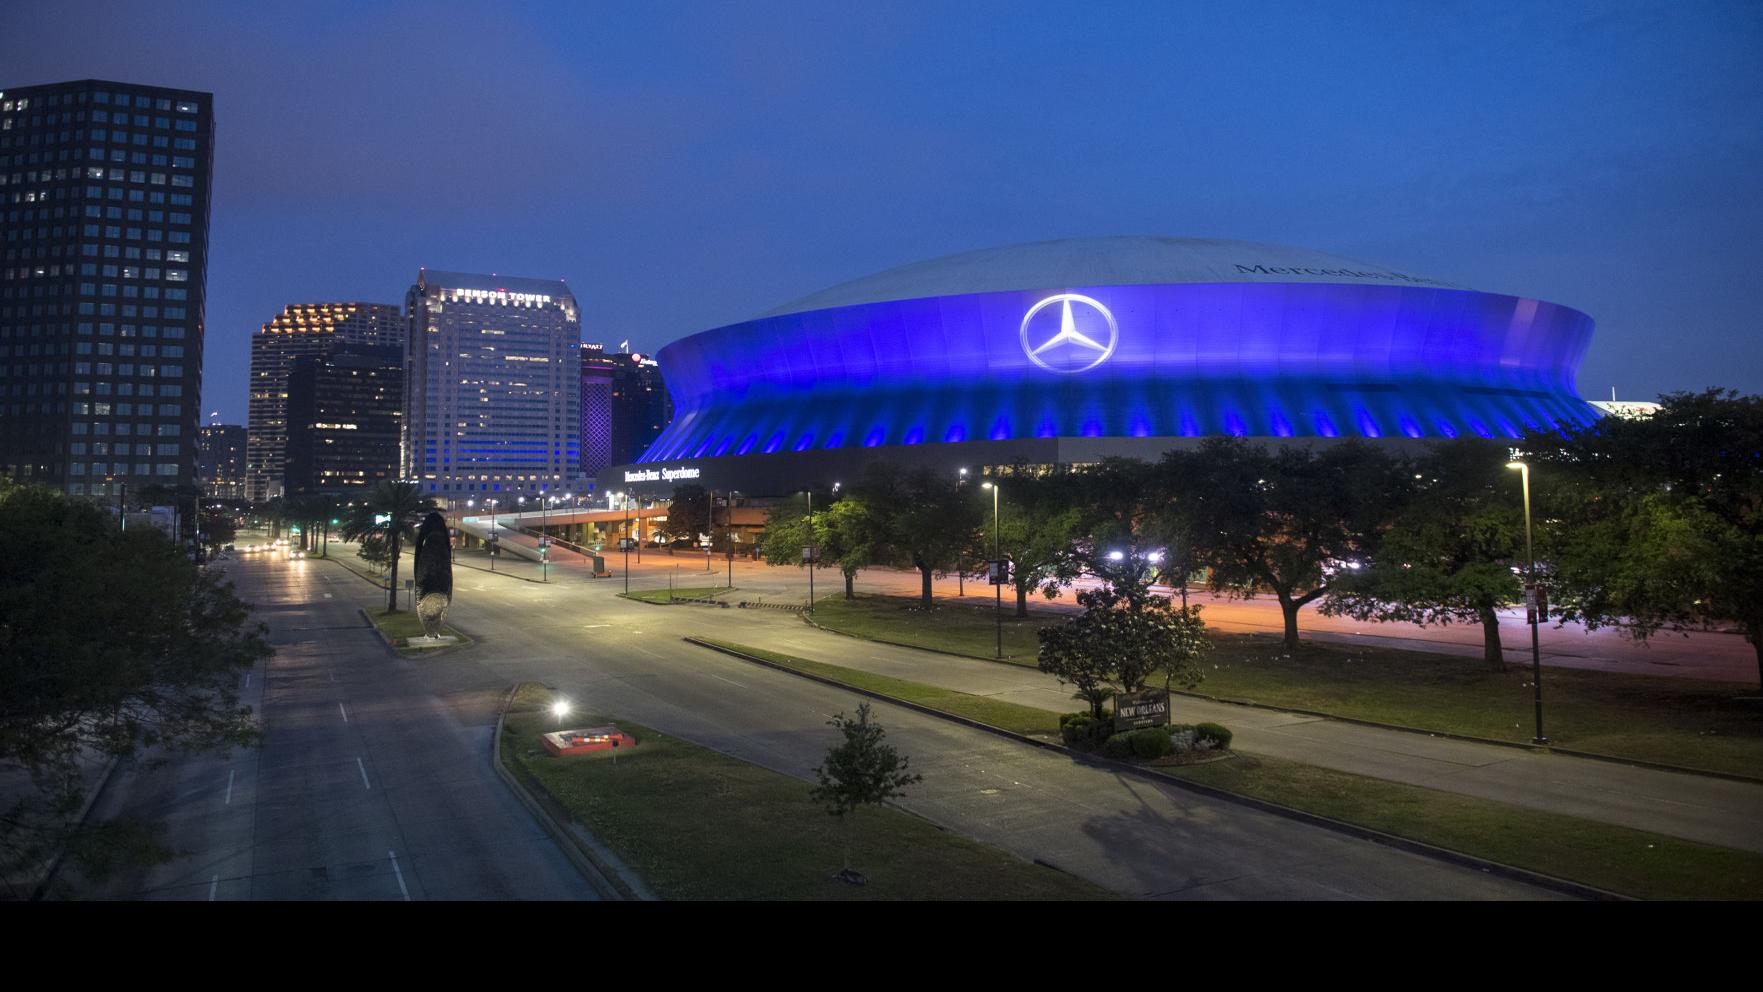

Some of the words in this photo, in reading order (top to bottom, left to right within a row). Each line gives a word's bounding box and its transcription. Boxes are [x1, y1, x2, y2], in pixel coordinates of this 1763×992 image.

[456, 288, 505, 298] BENSON
[509, 292, 550, 302] TOWER
[662, 467, 699, 482] Superdome
[1120, 707, 1136, 717] NEW
[1137, 703, 1165, 714] ORLEANS
